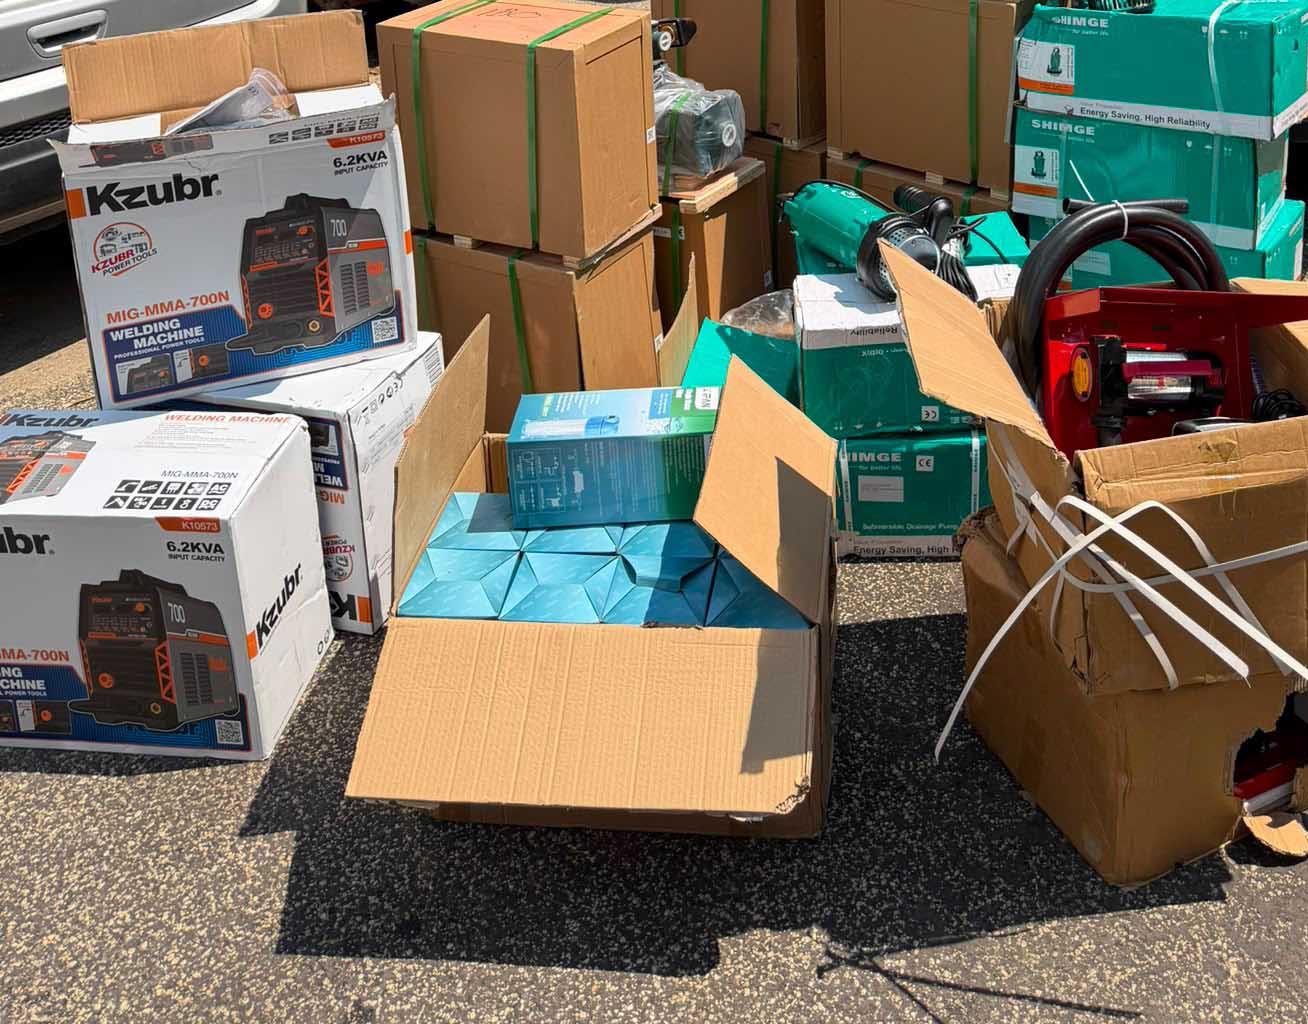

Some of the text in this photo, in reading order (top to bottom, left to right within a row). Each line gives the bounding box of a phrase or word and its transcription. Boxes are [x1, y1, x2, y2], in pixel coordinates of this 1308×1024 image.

[1080, 107, 1109, 119] Energy
[1145, 114, 1165, 126] High
[1167, 116, 1211, 130] Reliability
[333, 150, 388, 168] 6.2KVA
[356, 161, 388, 172] CAPACITY
[87, 174, 219, 216] Kzubr
[330, 219, 347, 237] 700
[91, 249, 135, 274] KZUBR
[103, 248, 158, 276] POWER TOOLS
[106, 290, 231, 324] MIG-MMA-700N
[110, 319, 181, 342] WELDING
[133, 326, 205, 350] MACHINE
[4, 413, 99, 427] Kzubr
[161, 470, 239, 479] MIG-MMA-700N
[181, 521, 219, 532] K10573
[167, 541, 224, 554] 6.2KVA
[854, 545, 885, 555] Energy
[927, 545, 949, 555] High
[168, 554, 225, 563] INPUT CAPACITY
[167, 602, 185, 624] 700
[255, 564, 302, 646] Kzubr
